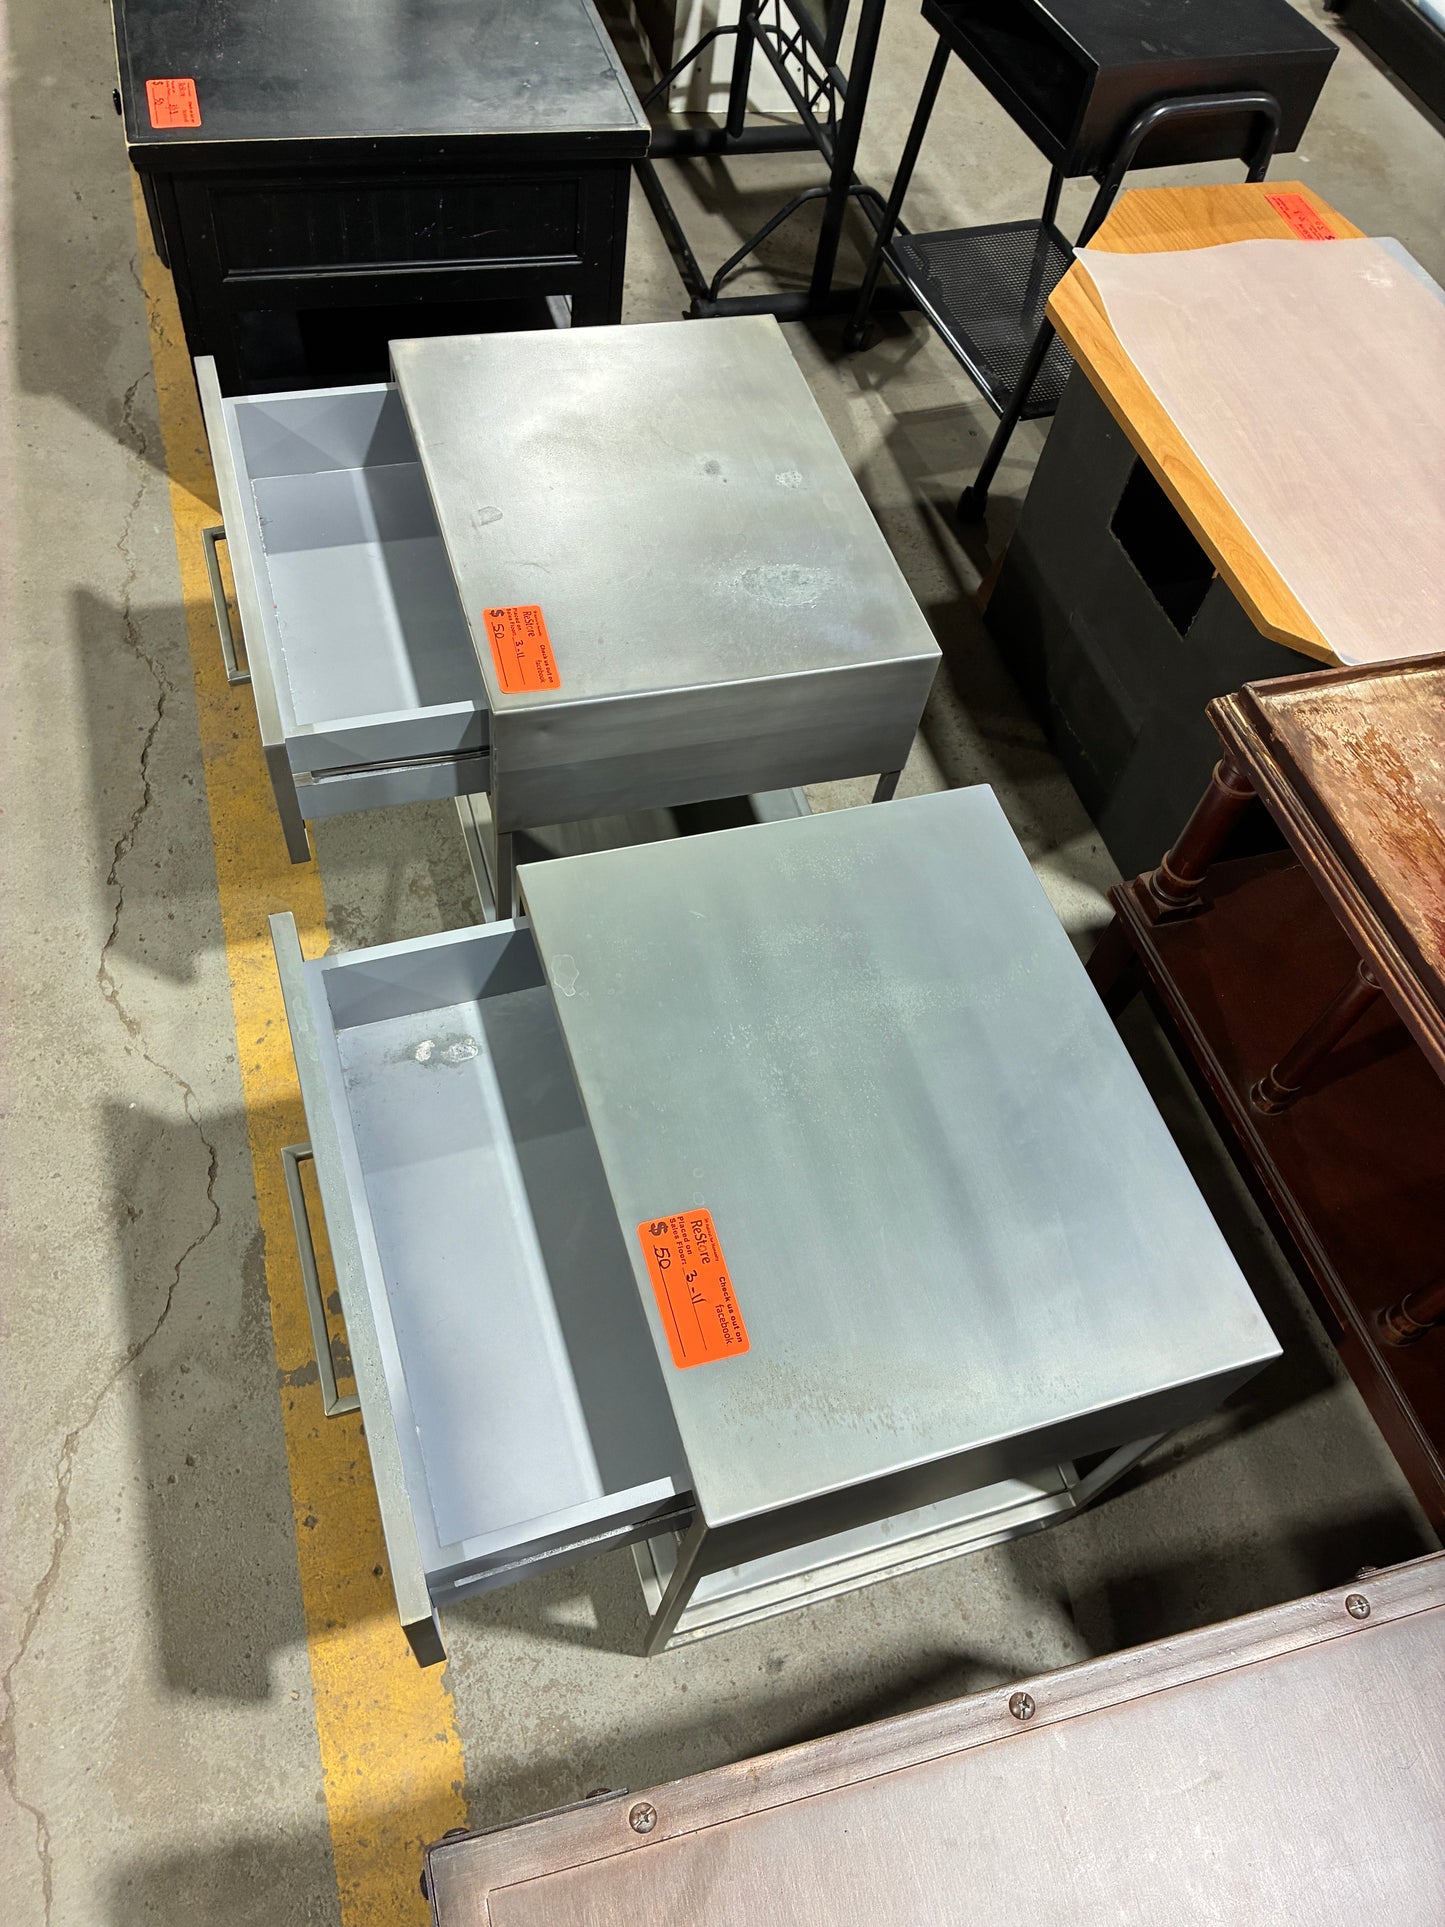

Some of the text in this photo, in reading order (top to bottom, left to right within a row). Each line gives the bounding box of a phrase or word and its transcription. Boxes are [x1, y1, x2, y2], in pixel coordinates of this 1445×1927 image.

[489, 609, 505, 639] $ 50
[648, 1221, 672, 1270] $ 50
[669, 1217, 687, 1265] Sales Floor:
[677, 1215, 693, 1255] Placed on
[690, 1219, 711, 1265] ReStore
[715, 1304, 734, 1345] facebook
[719, 1276, 743, 1343] Check us out on
